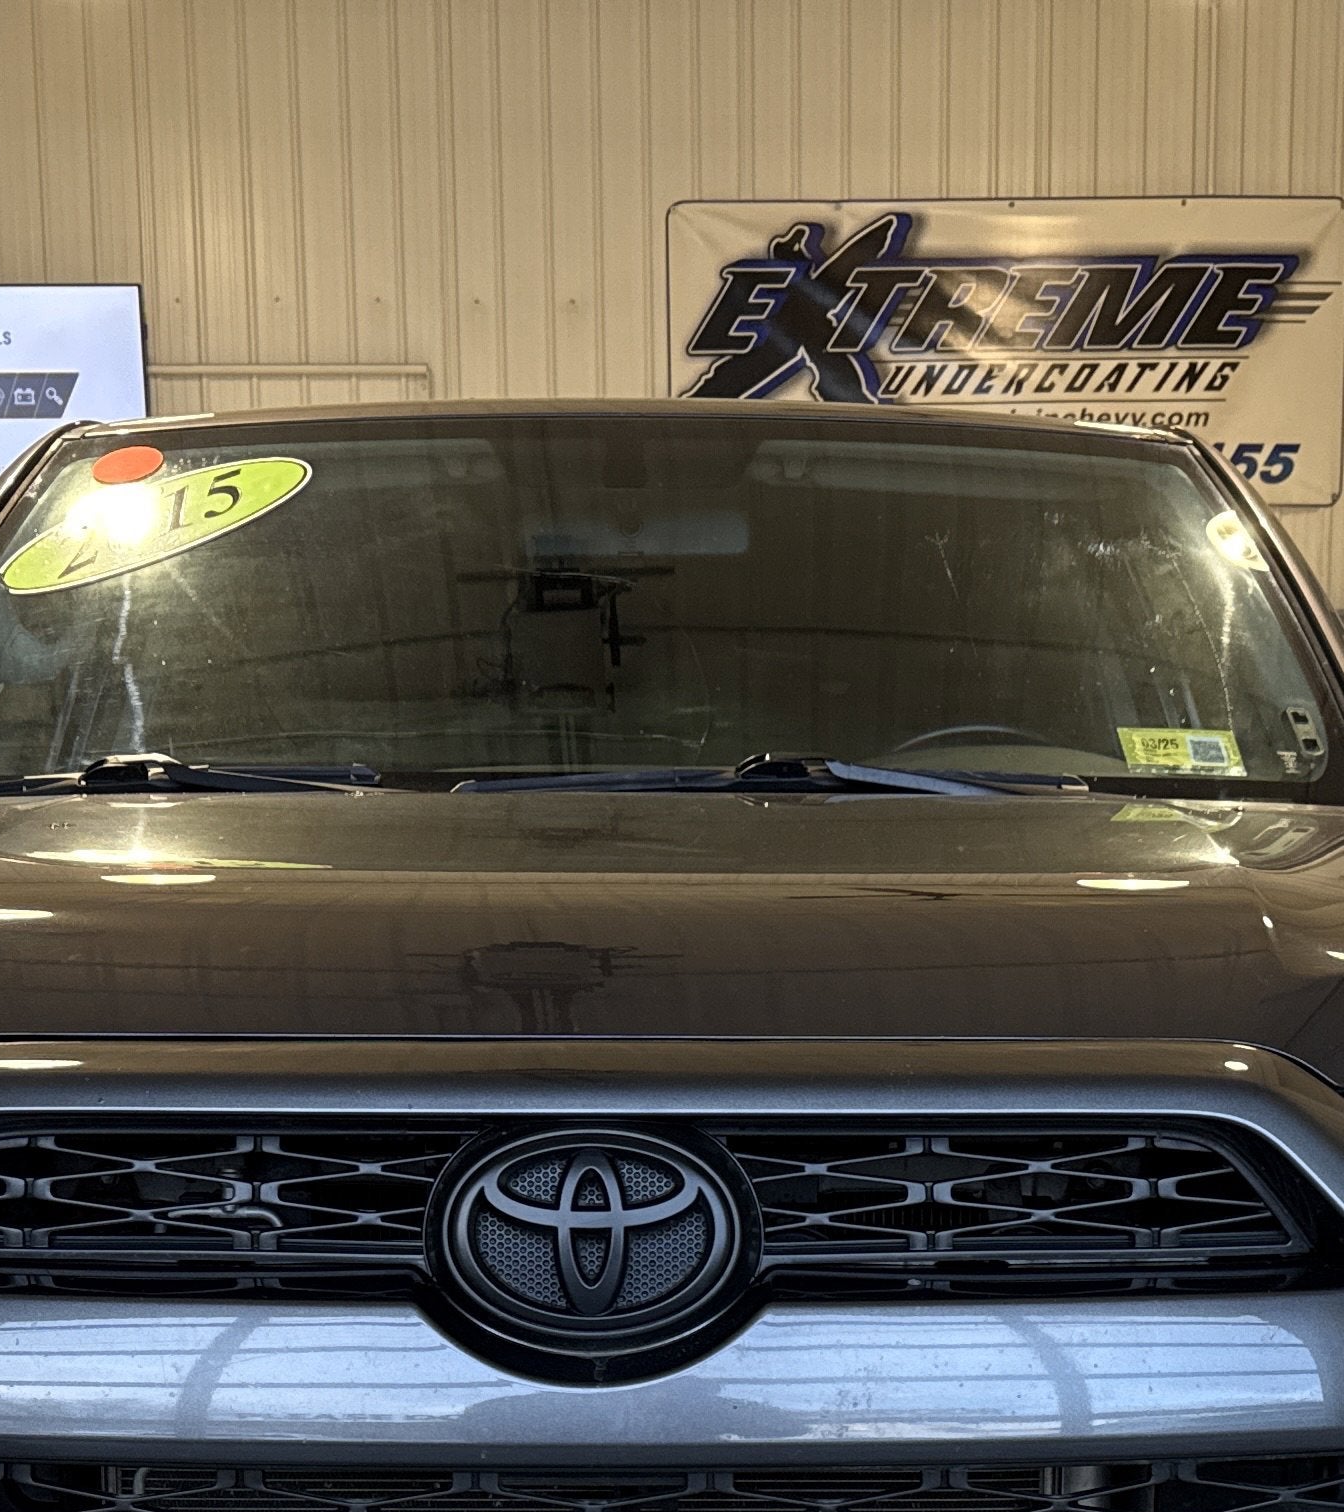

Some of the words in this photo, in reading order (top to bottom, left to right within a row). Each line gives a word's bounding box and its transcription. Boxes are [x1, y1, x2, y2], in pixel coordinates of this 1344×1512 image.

[682, 212, 1299, 403] EXTREME
[878, 361, 1240, 397] UNDERCOATING
[1141, 737, 1180, 750] 03/25
